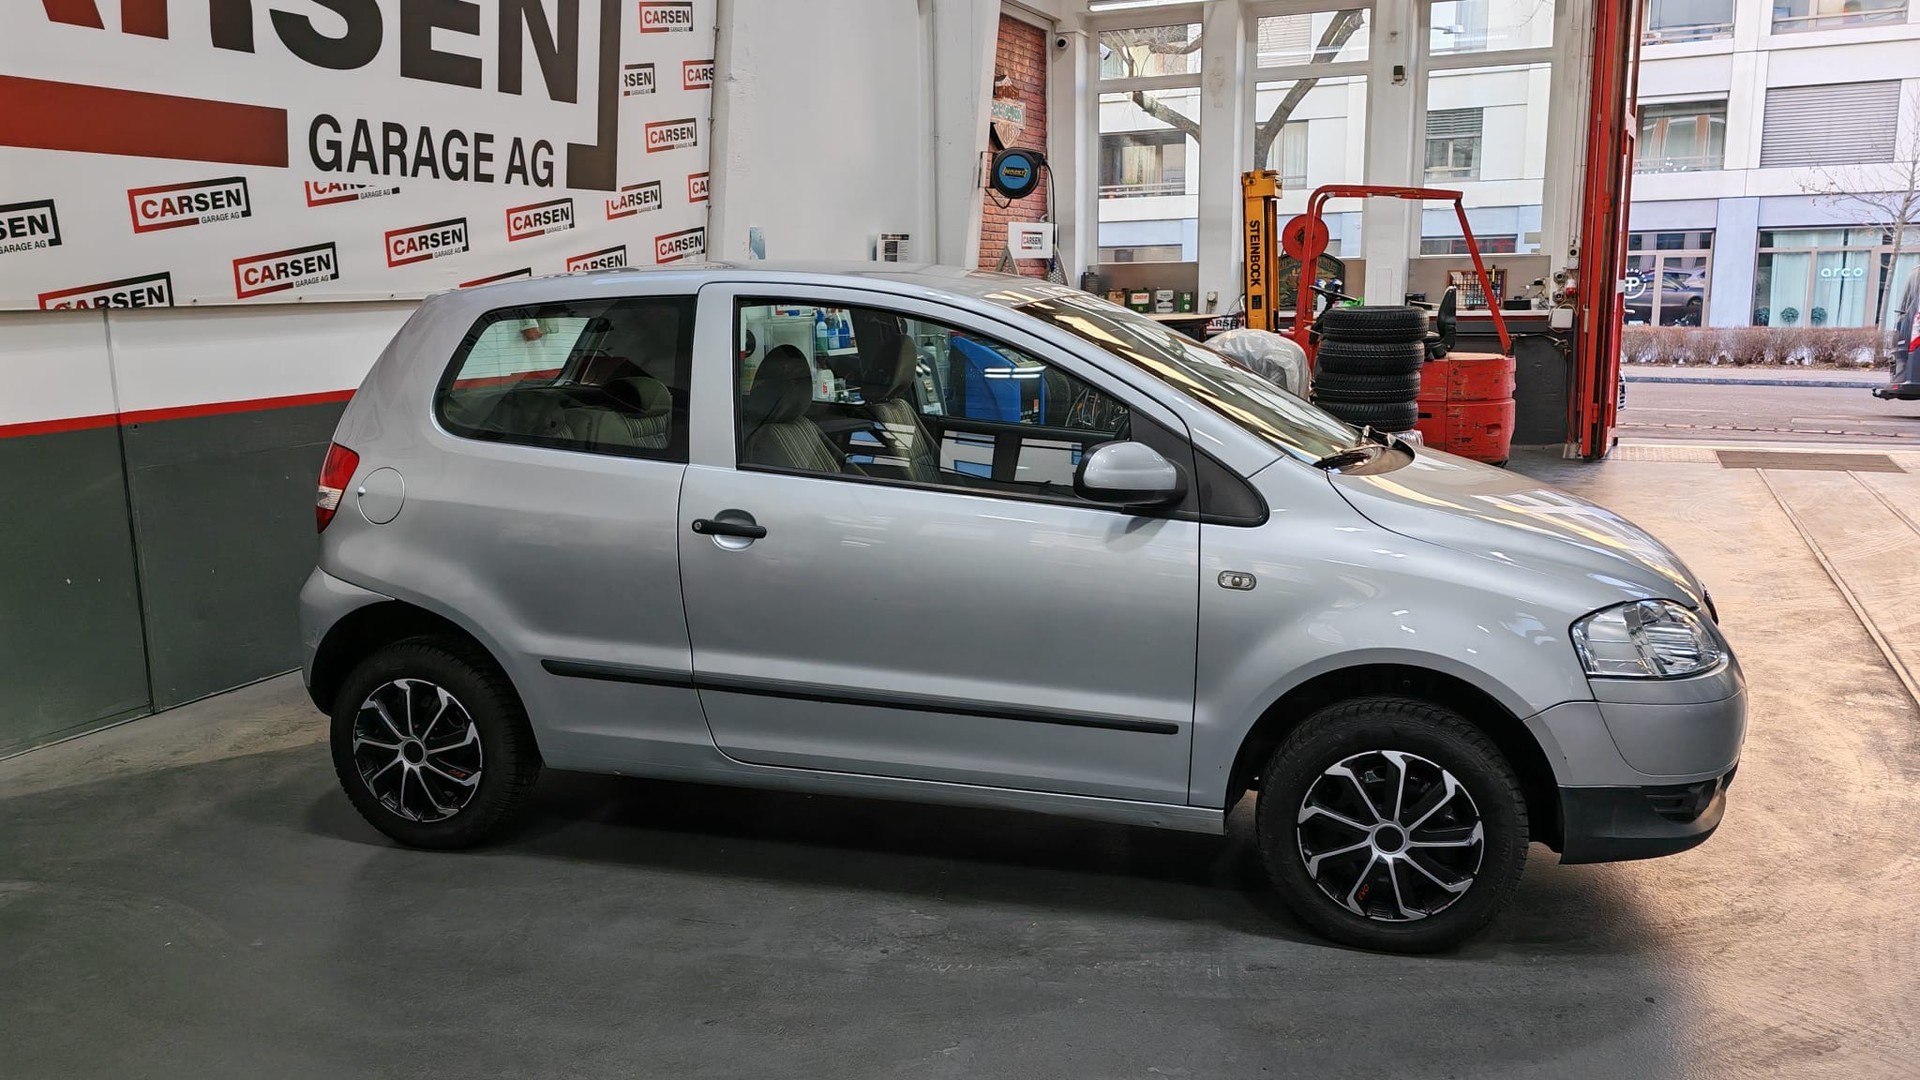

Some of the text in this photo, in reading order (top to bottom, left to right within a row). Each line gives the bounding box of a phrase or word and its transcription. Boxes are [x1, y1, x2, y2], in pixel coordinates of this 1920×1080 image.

[644, 10, 690, 24] CARSEN
[650, 126, 694, 144] CARSEN
[308, 113, 554, 188] GARAGE AG
[141, 188, 242, 219] CARSEN
[201, 211, 240, 224] GARAGE AG
[513, 206, 570, 231] CARSEN
[34, 240, 46, 249] AG
[393, 228, 463, 256] CARSEN
[660, 235, 702, 255] CARSEN
[1249, 220, 1261, 287] STEINBOCK
[244, 253, 331, 286] CARSEN
[1821, 267, 1863, 277] arco
[295, 276, 319, 287] GARAGE
